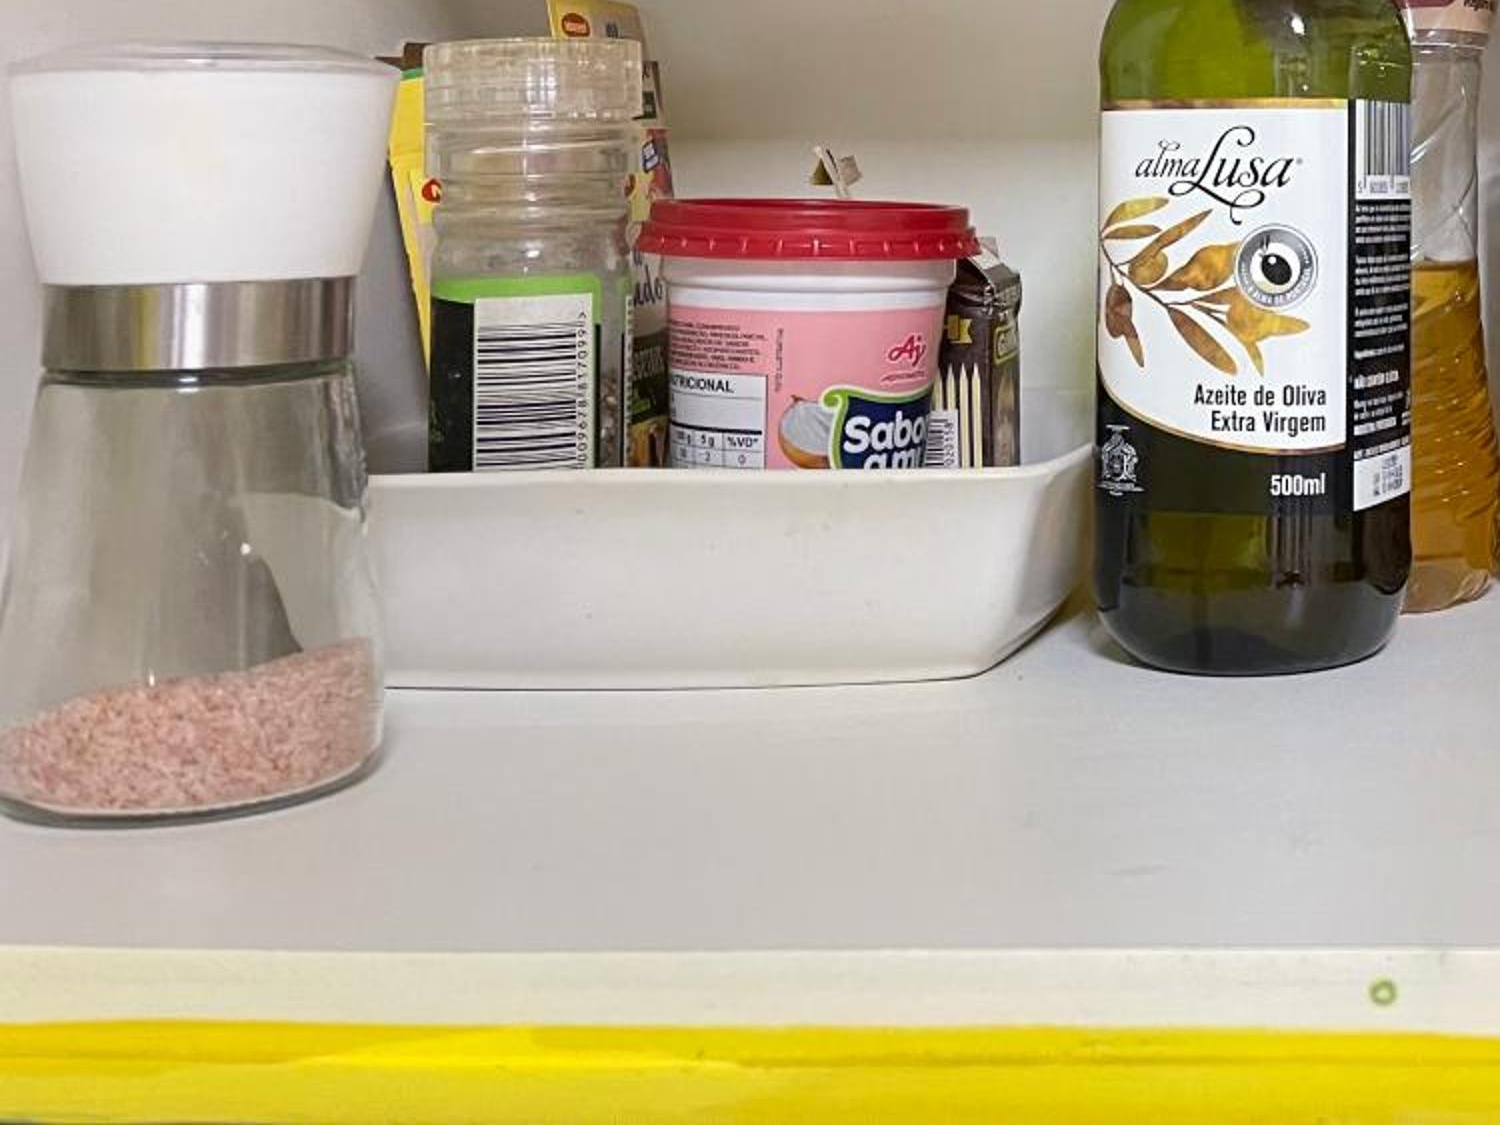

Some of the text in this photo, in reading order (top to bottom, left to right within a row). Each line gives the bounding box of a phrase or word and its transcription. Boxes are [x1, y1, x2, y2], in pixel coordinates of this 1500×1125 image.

[1194, 383, 1327, 407] Azeite de Oliva
[1211, 410, 1256, 432] Extra
[1263, 410, 1326, 438] Virgem
[1270, 472, 1326, 496] 500ml
